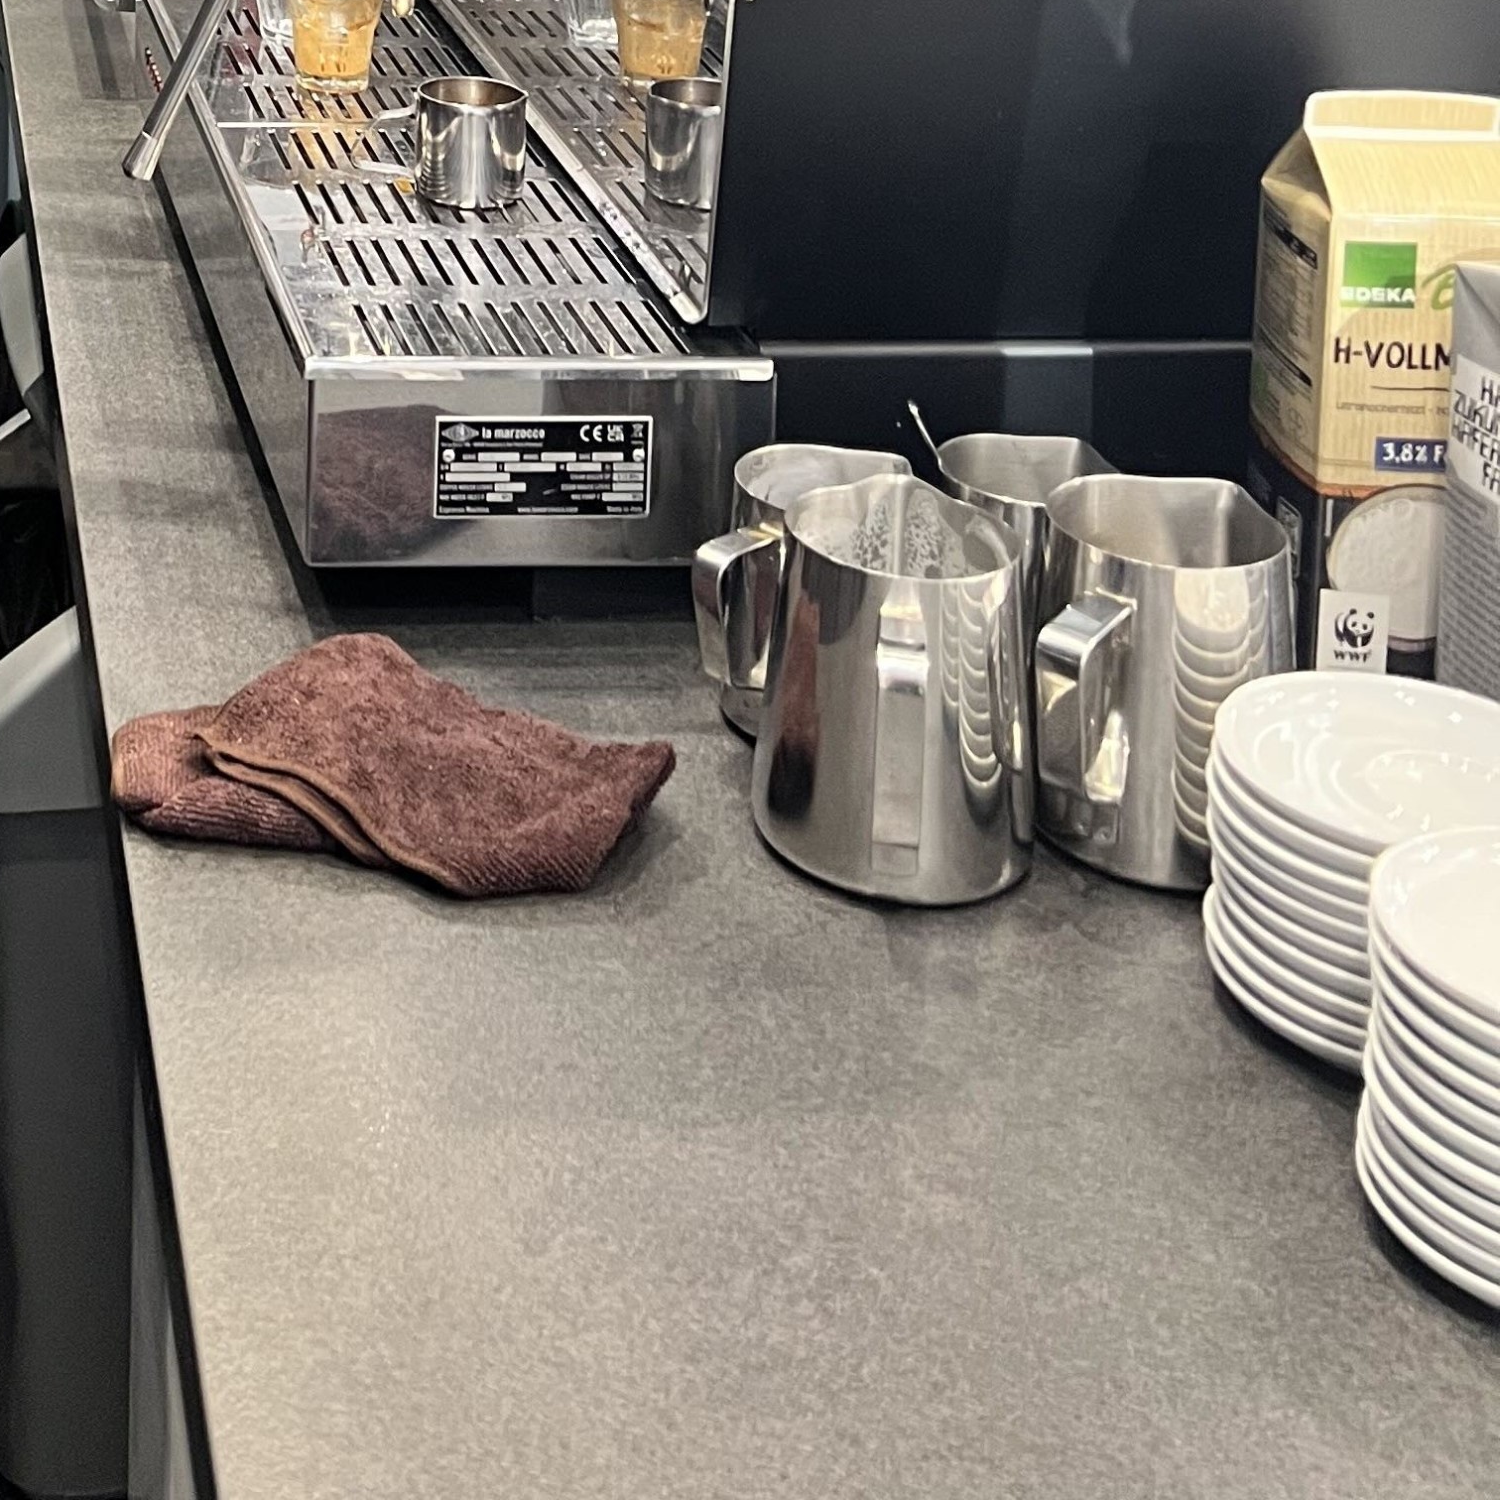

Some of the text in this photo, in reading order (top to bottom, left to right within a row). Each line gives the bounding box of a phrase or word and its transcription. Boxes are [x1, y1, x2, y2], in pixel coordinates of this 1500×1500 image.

[1341, 286, 1416, 303] EDEKA
[482, 426, 545, 439] la marzocco
[1333, 649, 1372, 663] WWF
